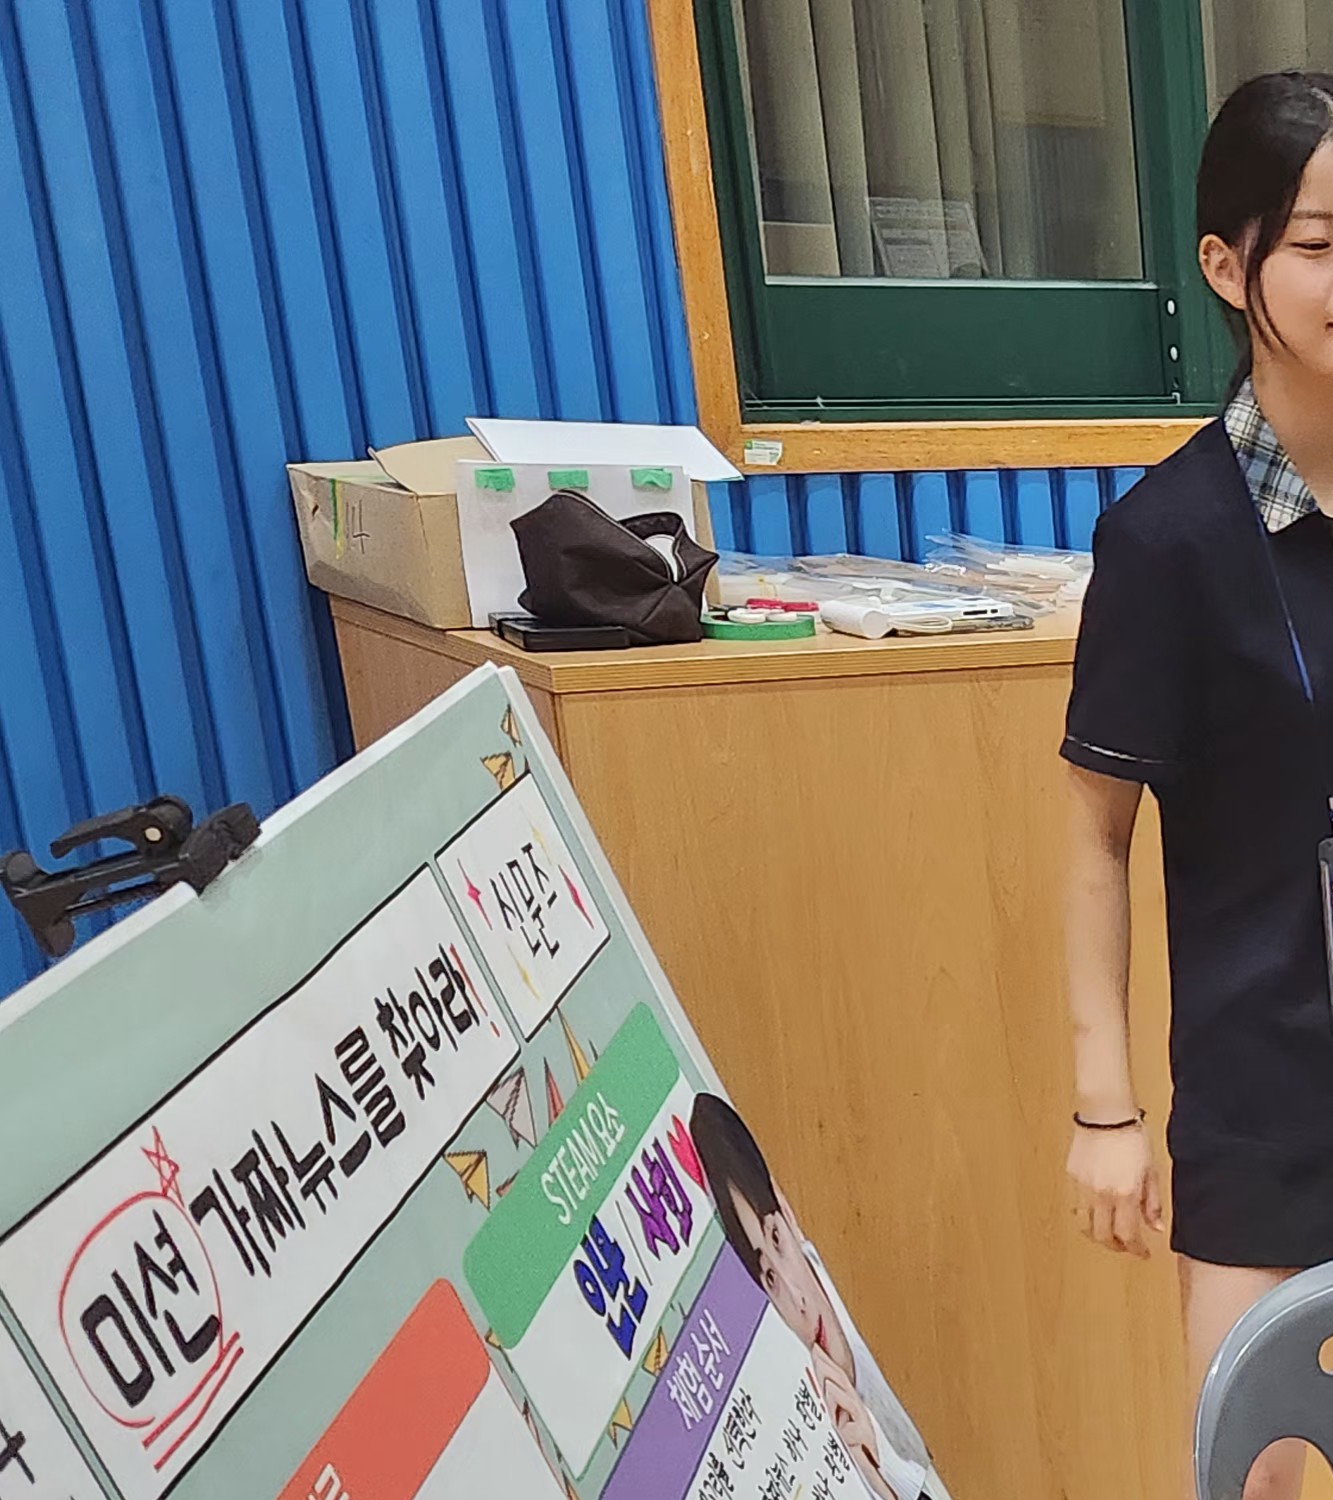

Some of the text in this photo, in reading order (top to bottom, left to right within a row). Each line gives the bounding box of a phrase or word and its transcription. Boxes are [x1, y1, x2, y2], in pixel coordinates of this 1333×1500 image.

[490, 842, 561, 960] 신문즈
[79, 943, 501, 1407] 미션 가짜뉴스를 찾아라!
[541, 1092, 625, 1223] STEAM 요소
[573, 1137, 694, 1361] 인문 사회
[666, 1309, 730, 1428] 체험 순서
[722, 1387, 761, 1469] 선택한다
[781, 1418, 808, 1462] 하나
[822, 1431, 850, 1484] 판별
